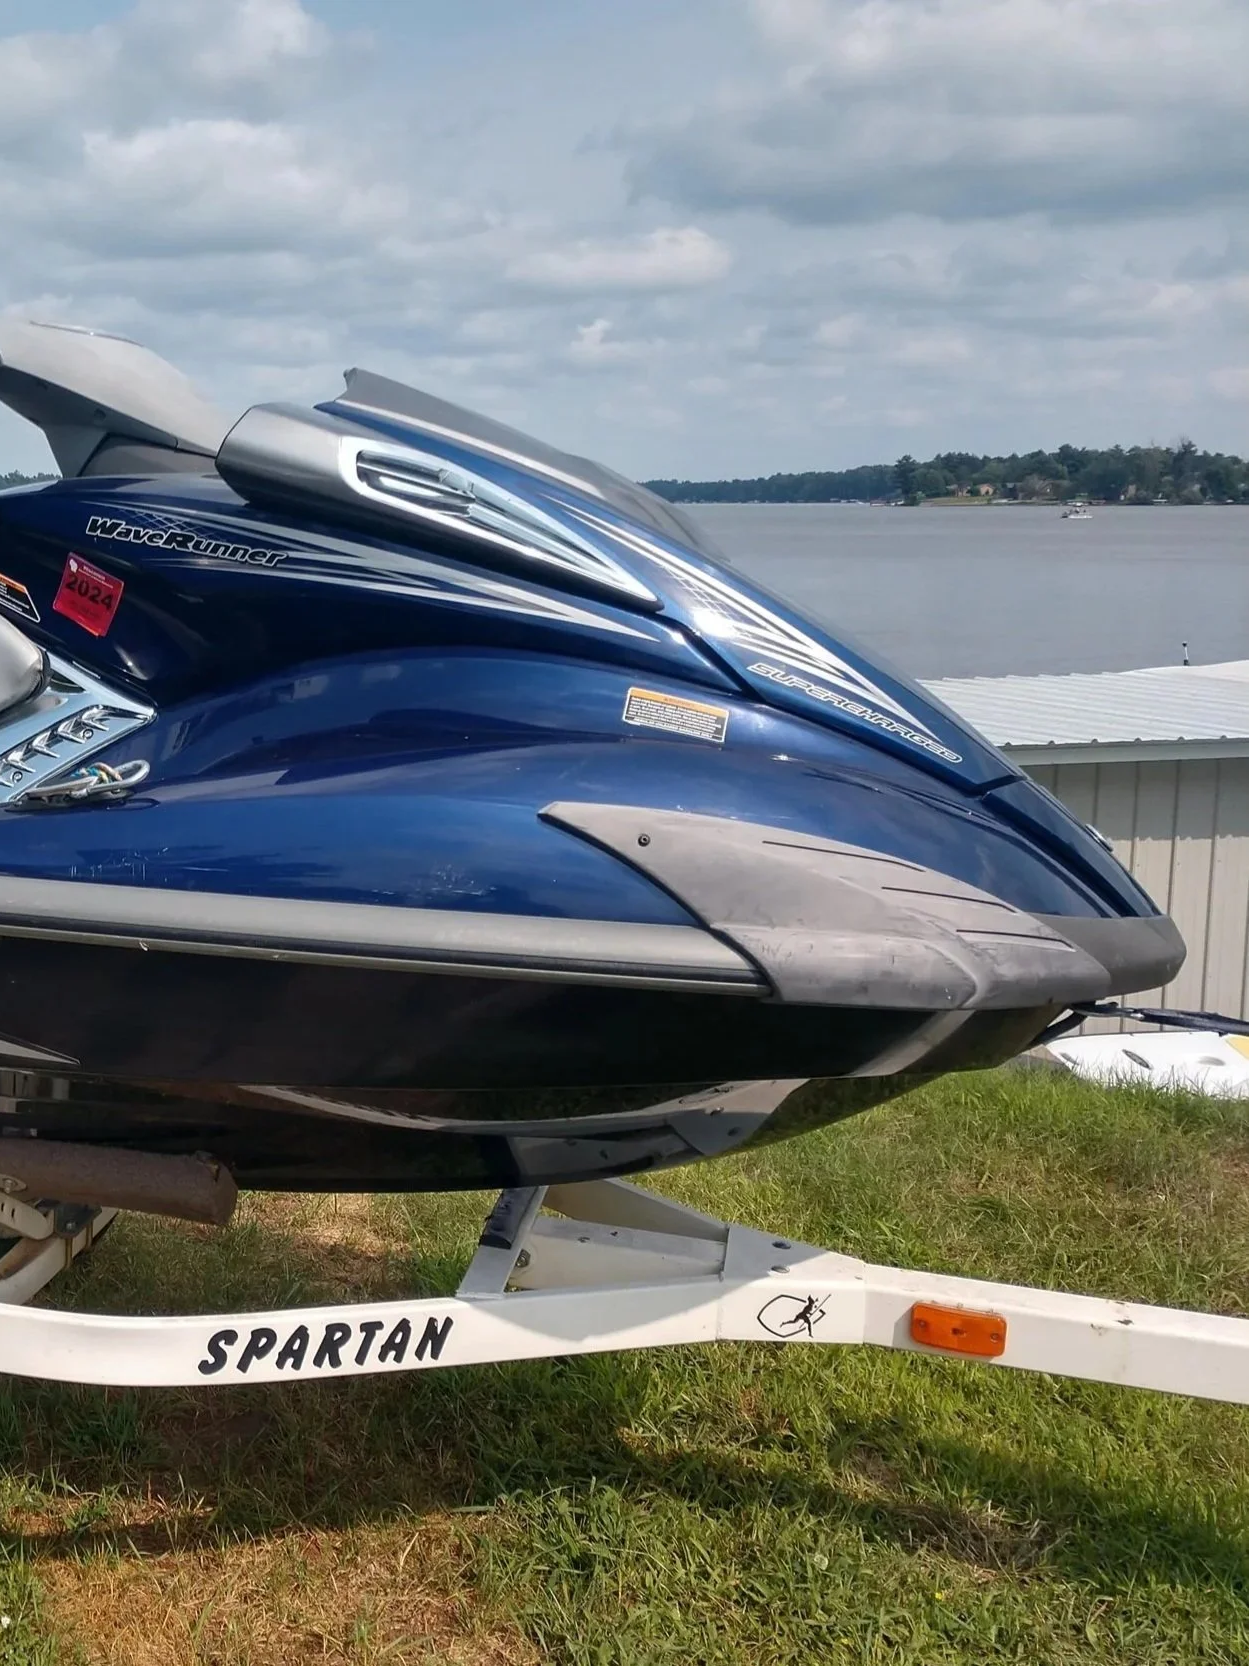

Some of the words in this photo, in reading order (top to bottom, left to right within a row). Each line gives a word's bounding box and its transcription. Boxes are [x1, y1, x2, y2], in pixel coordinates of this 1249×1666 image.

[86, 515, 290, 568] WaveRunner
[65, 573, 114, 611] 2024
[746, 662, 963, 764] SUPERCHARGED
[198, 1316, 454, 1376] SPARTAN
